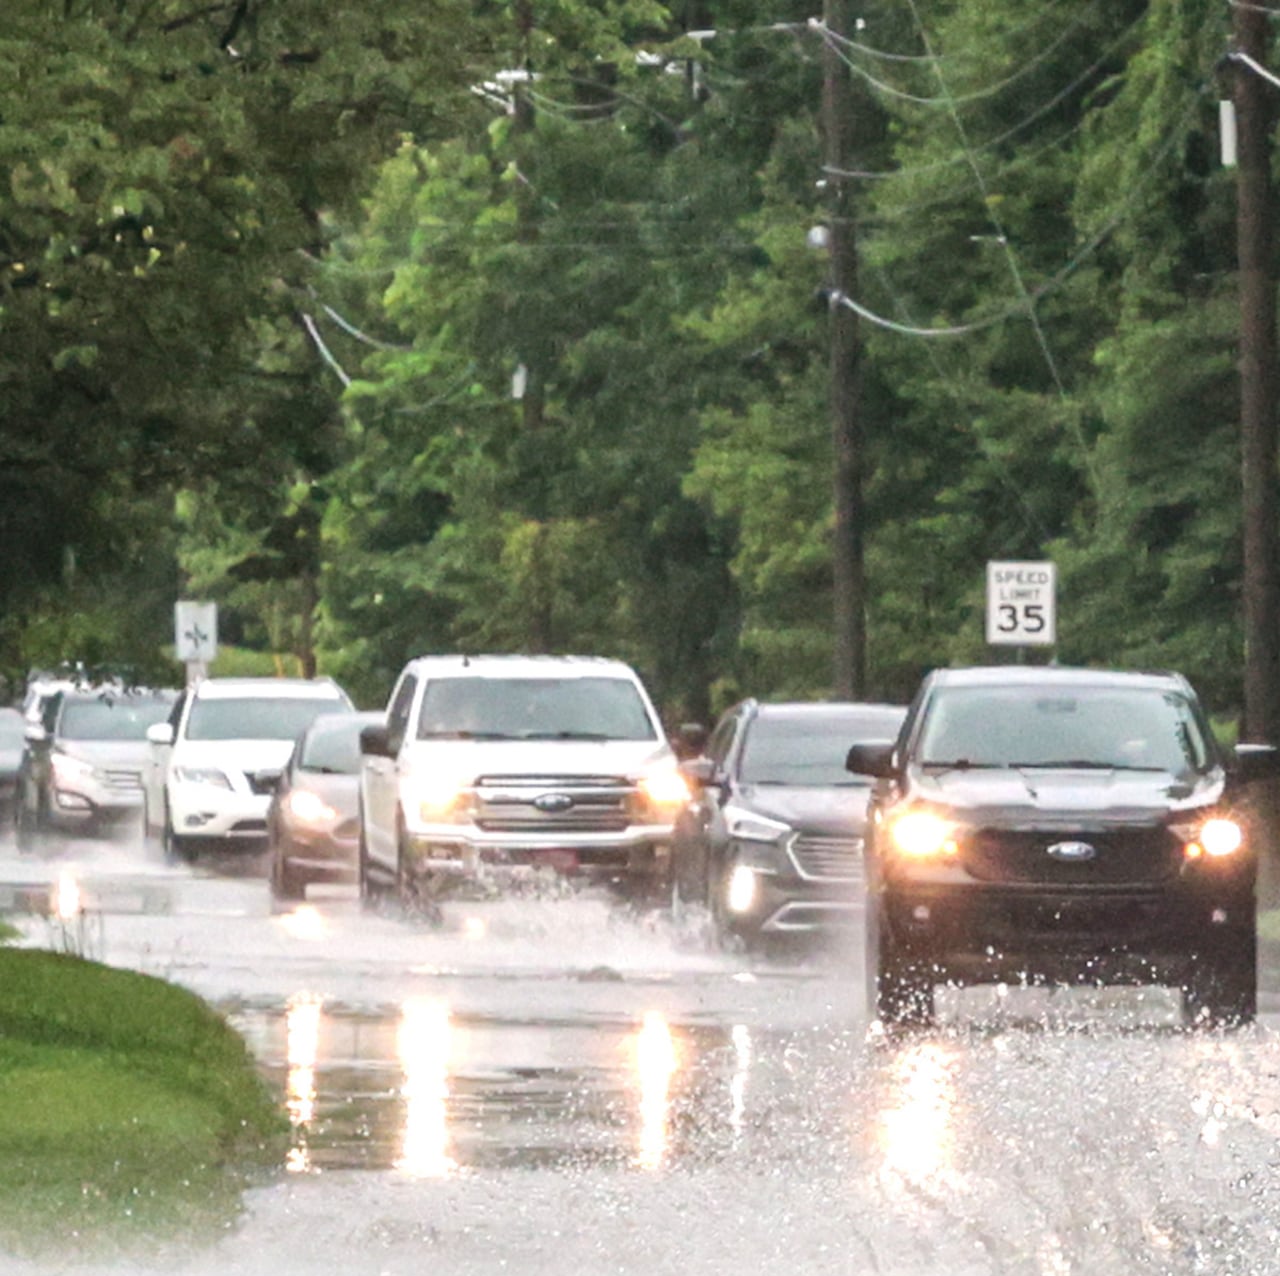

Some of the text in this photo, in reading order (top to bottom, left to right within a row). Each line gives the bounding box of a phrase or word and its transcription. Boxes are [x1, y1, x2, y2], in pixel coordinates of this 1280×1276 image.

[995, 570, 1049, 584] SPEED
[1000, 588, 1040, 600] LIMIT
[997, 603, 1045, 633] 35
